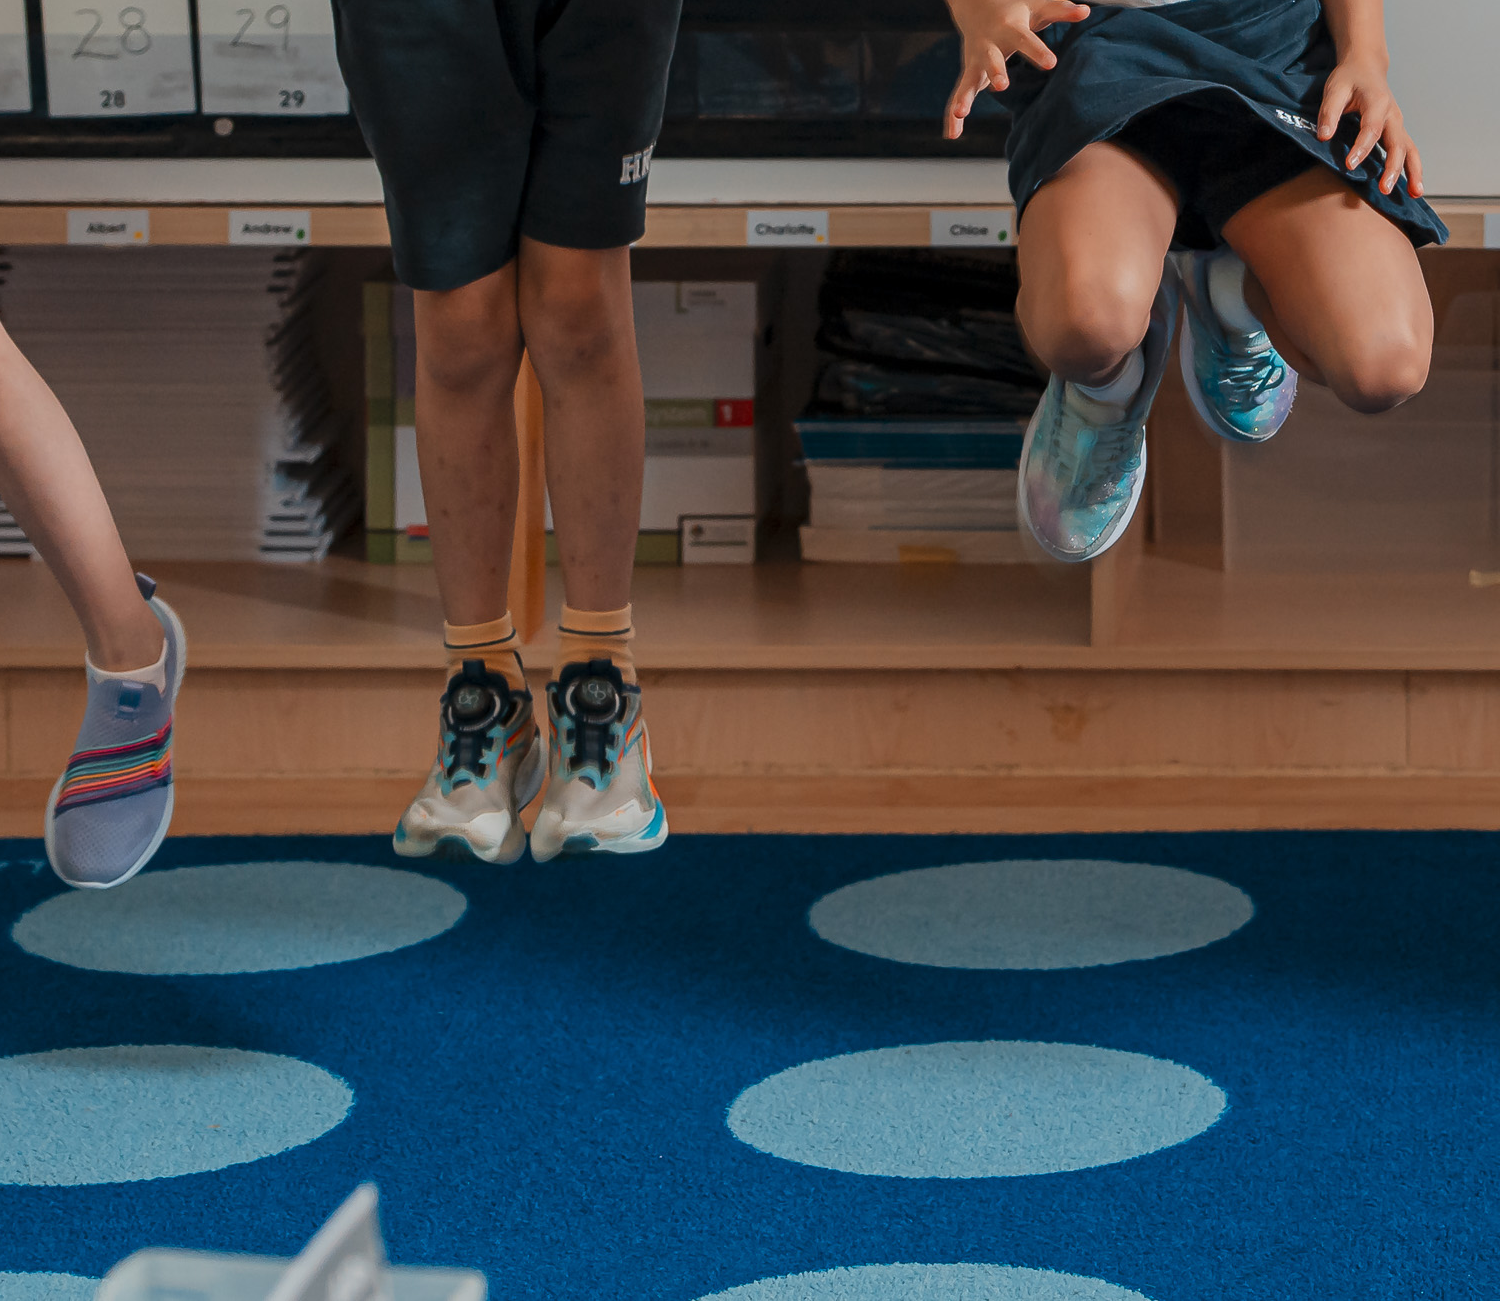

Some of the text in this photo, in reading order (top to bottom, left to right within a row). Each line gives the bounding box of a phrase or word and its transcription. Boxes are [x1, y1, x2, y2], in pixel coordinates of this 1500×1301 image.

[73, 7, 151, 59] 28
[230, 4, 290, 49] 29
[242, 222, 293, 234] Andrew
[756, 222, 988, 236] Charlotte Chloe
